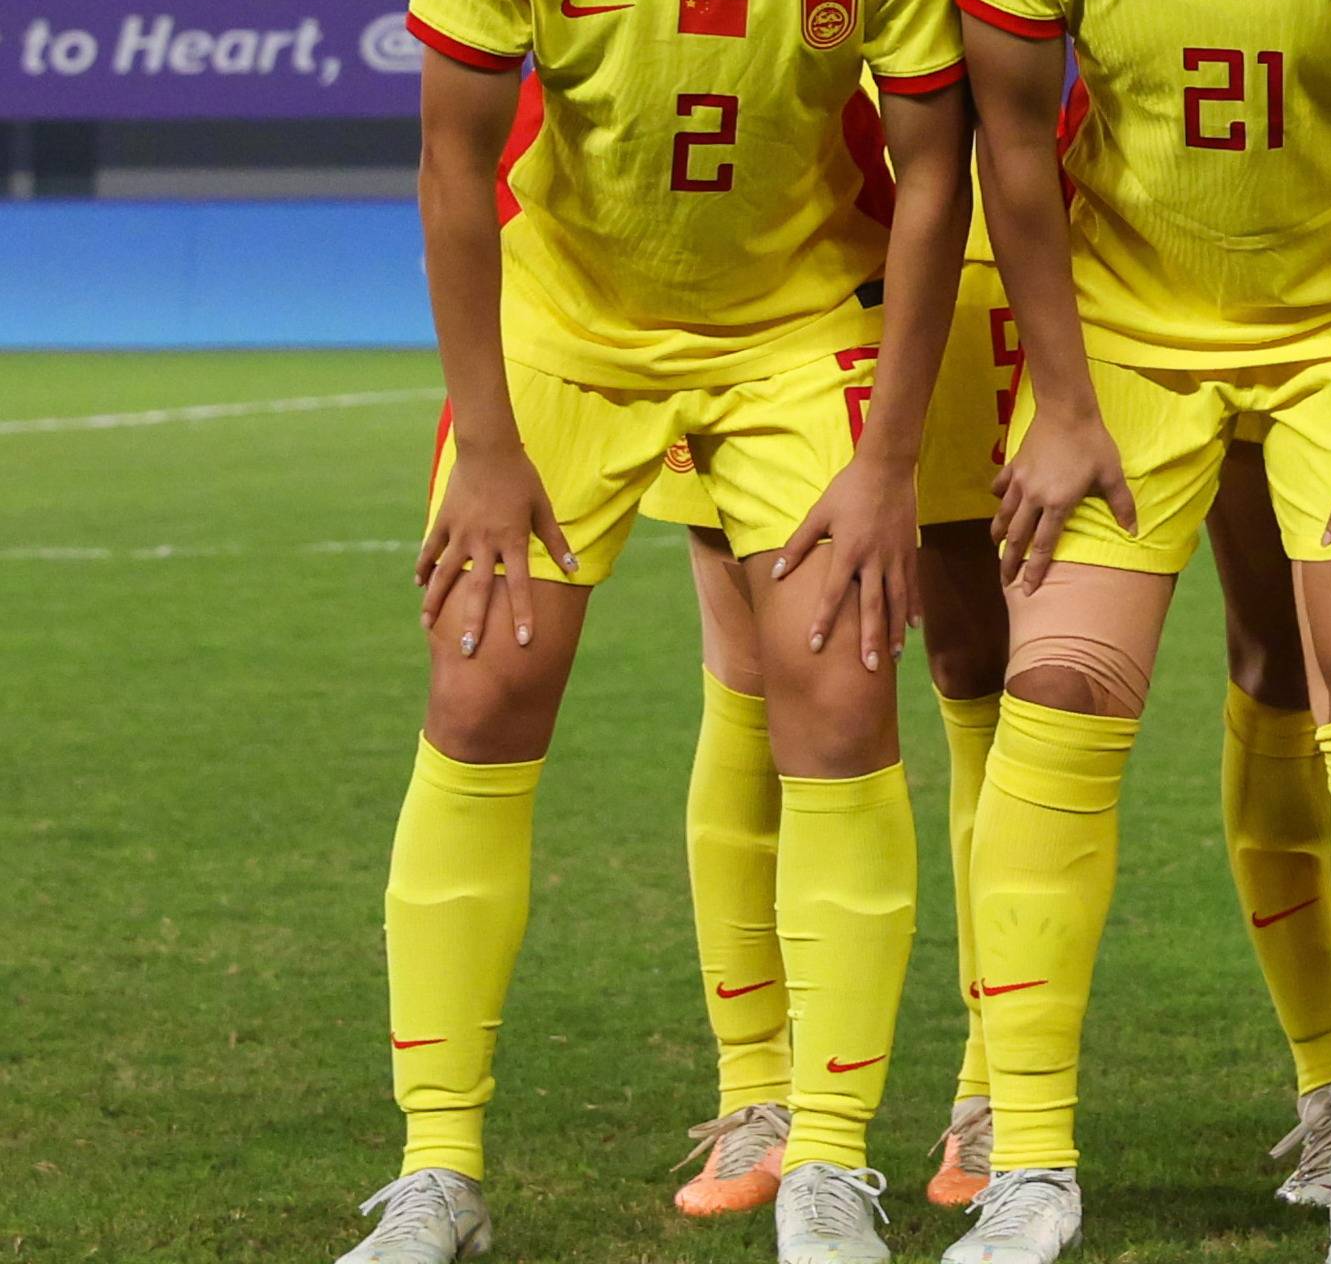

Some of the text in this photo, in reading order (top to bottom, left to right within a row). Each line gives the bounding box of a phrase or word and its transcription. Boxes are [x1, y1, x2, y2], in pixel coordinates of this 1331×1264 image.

[22, 17, 98, 75] to
[113, 14, 341, 86] Heart,
[1183, 47, 1284, 151] 21
[670, 94, 739, 192] 2
